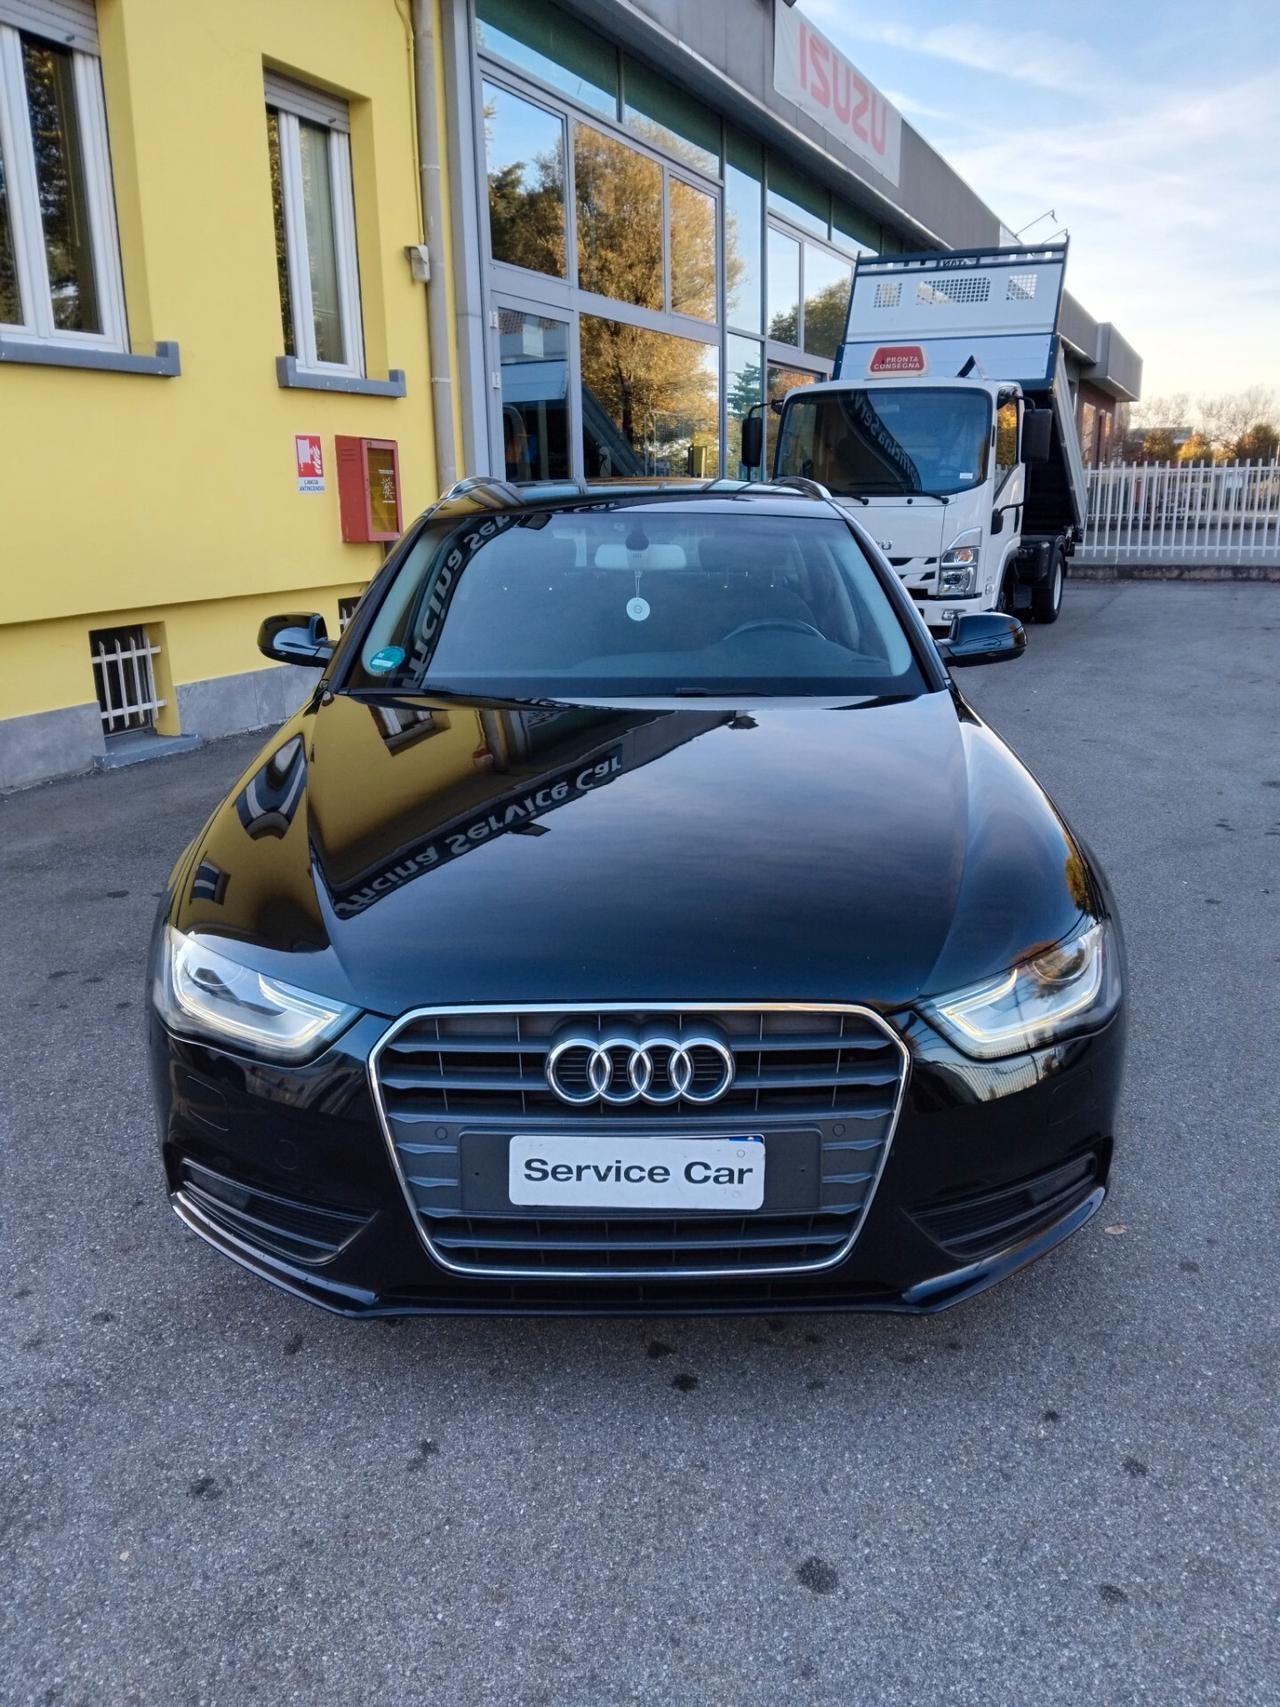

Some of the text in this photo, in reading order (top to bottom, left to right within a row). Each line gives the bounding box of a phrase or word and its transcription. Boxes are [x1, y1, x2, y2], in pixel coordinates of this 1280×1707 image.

[799, 22, 887, 156] ISUZU
[873, 362, 920, 370] CONSEGNA
[524, 1158, 753, 1185] Service Car
